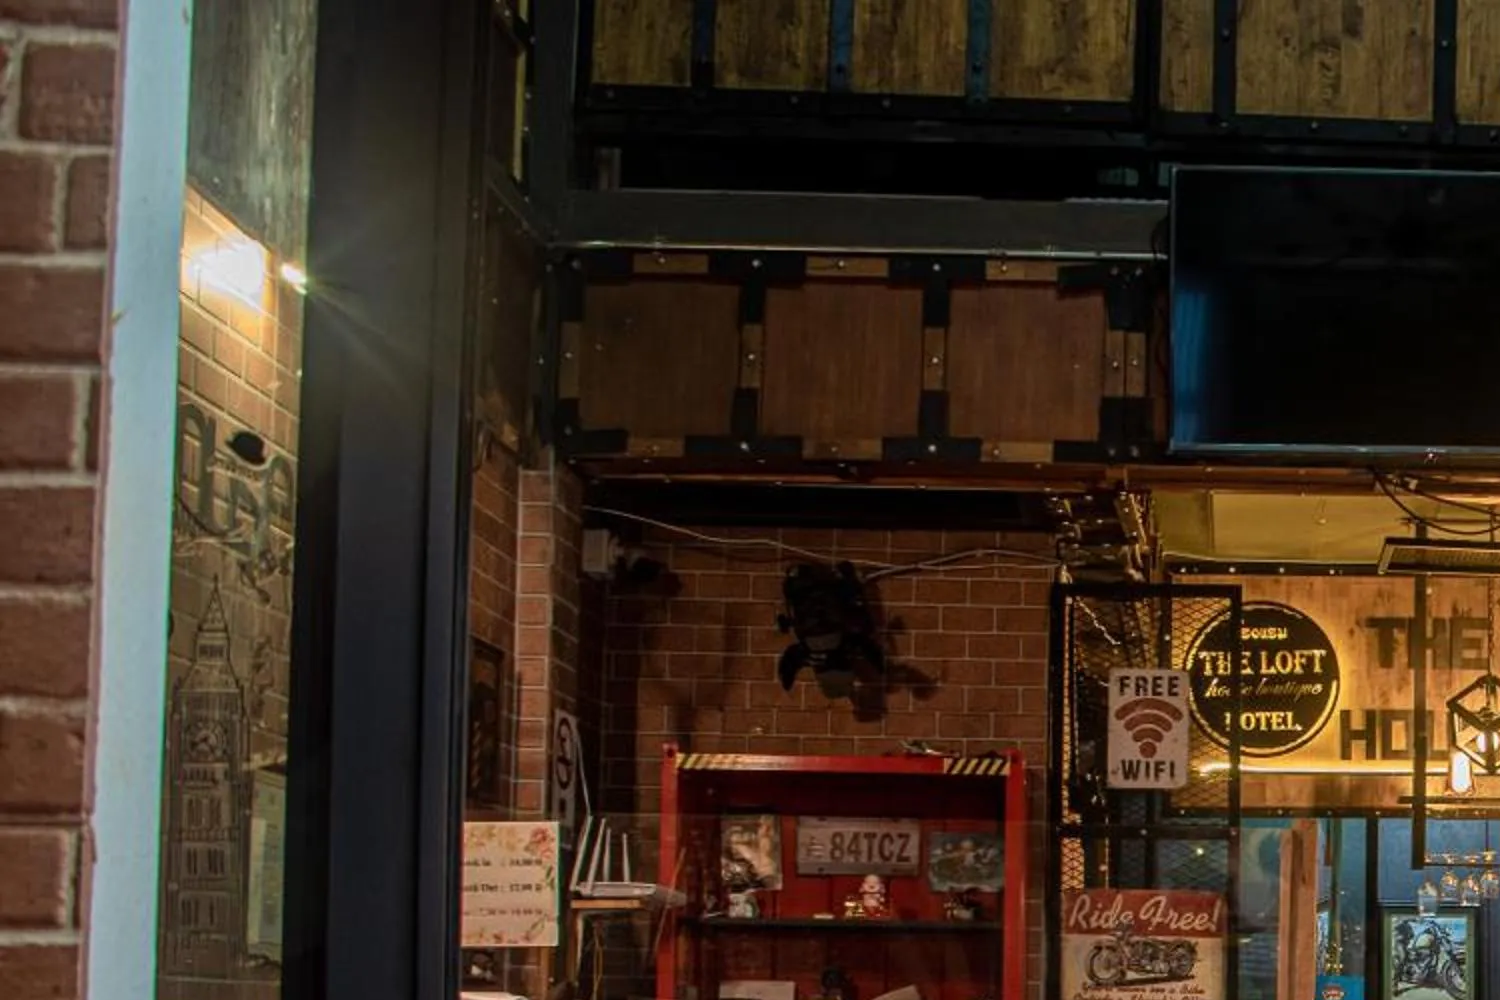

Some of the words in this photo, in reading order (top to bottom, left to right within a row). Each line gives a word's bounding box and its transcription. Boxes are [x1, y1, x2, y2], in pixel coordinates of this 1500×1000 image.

[1260, 649, 1327, 675] LOFT
[1118, 675, 1181, 697] FREE
[1121, 760, 1176, 782] WIFI
[1069, 893, 1135, 930] Ride
[1139, 895, 1221, 932] Free!
